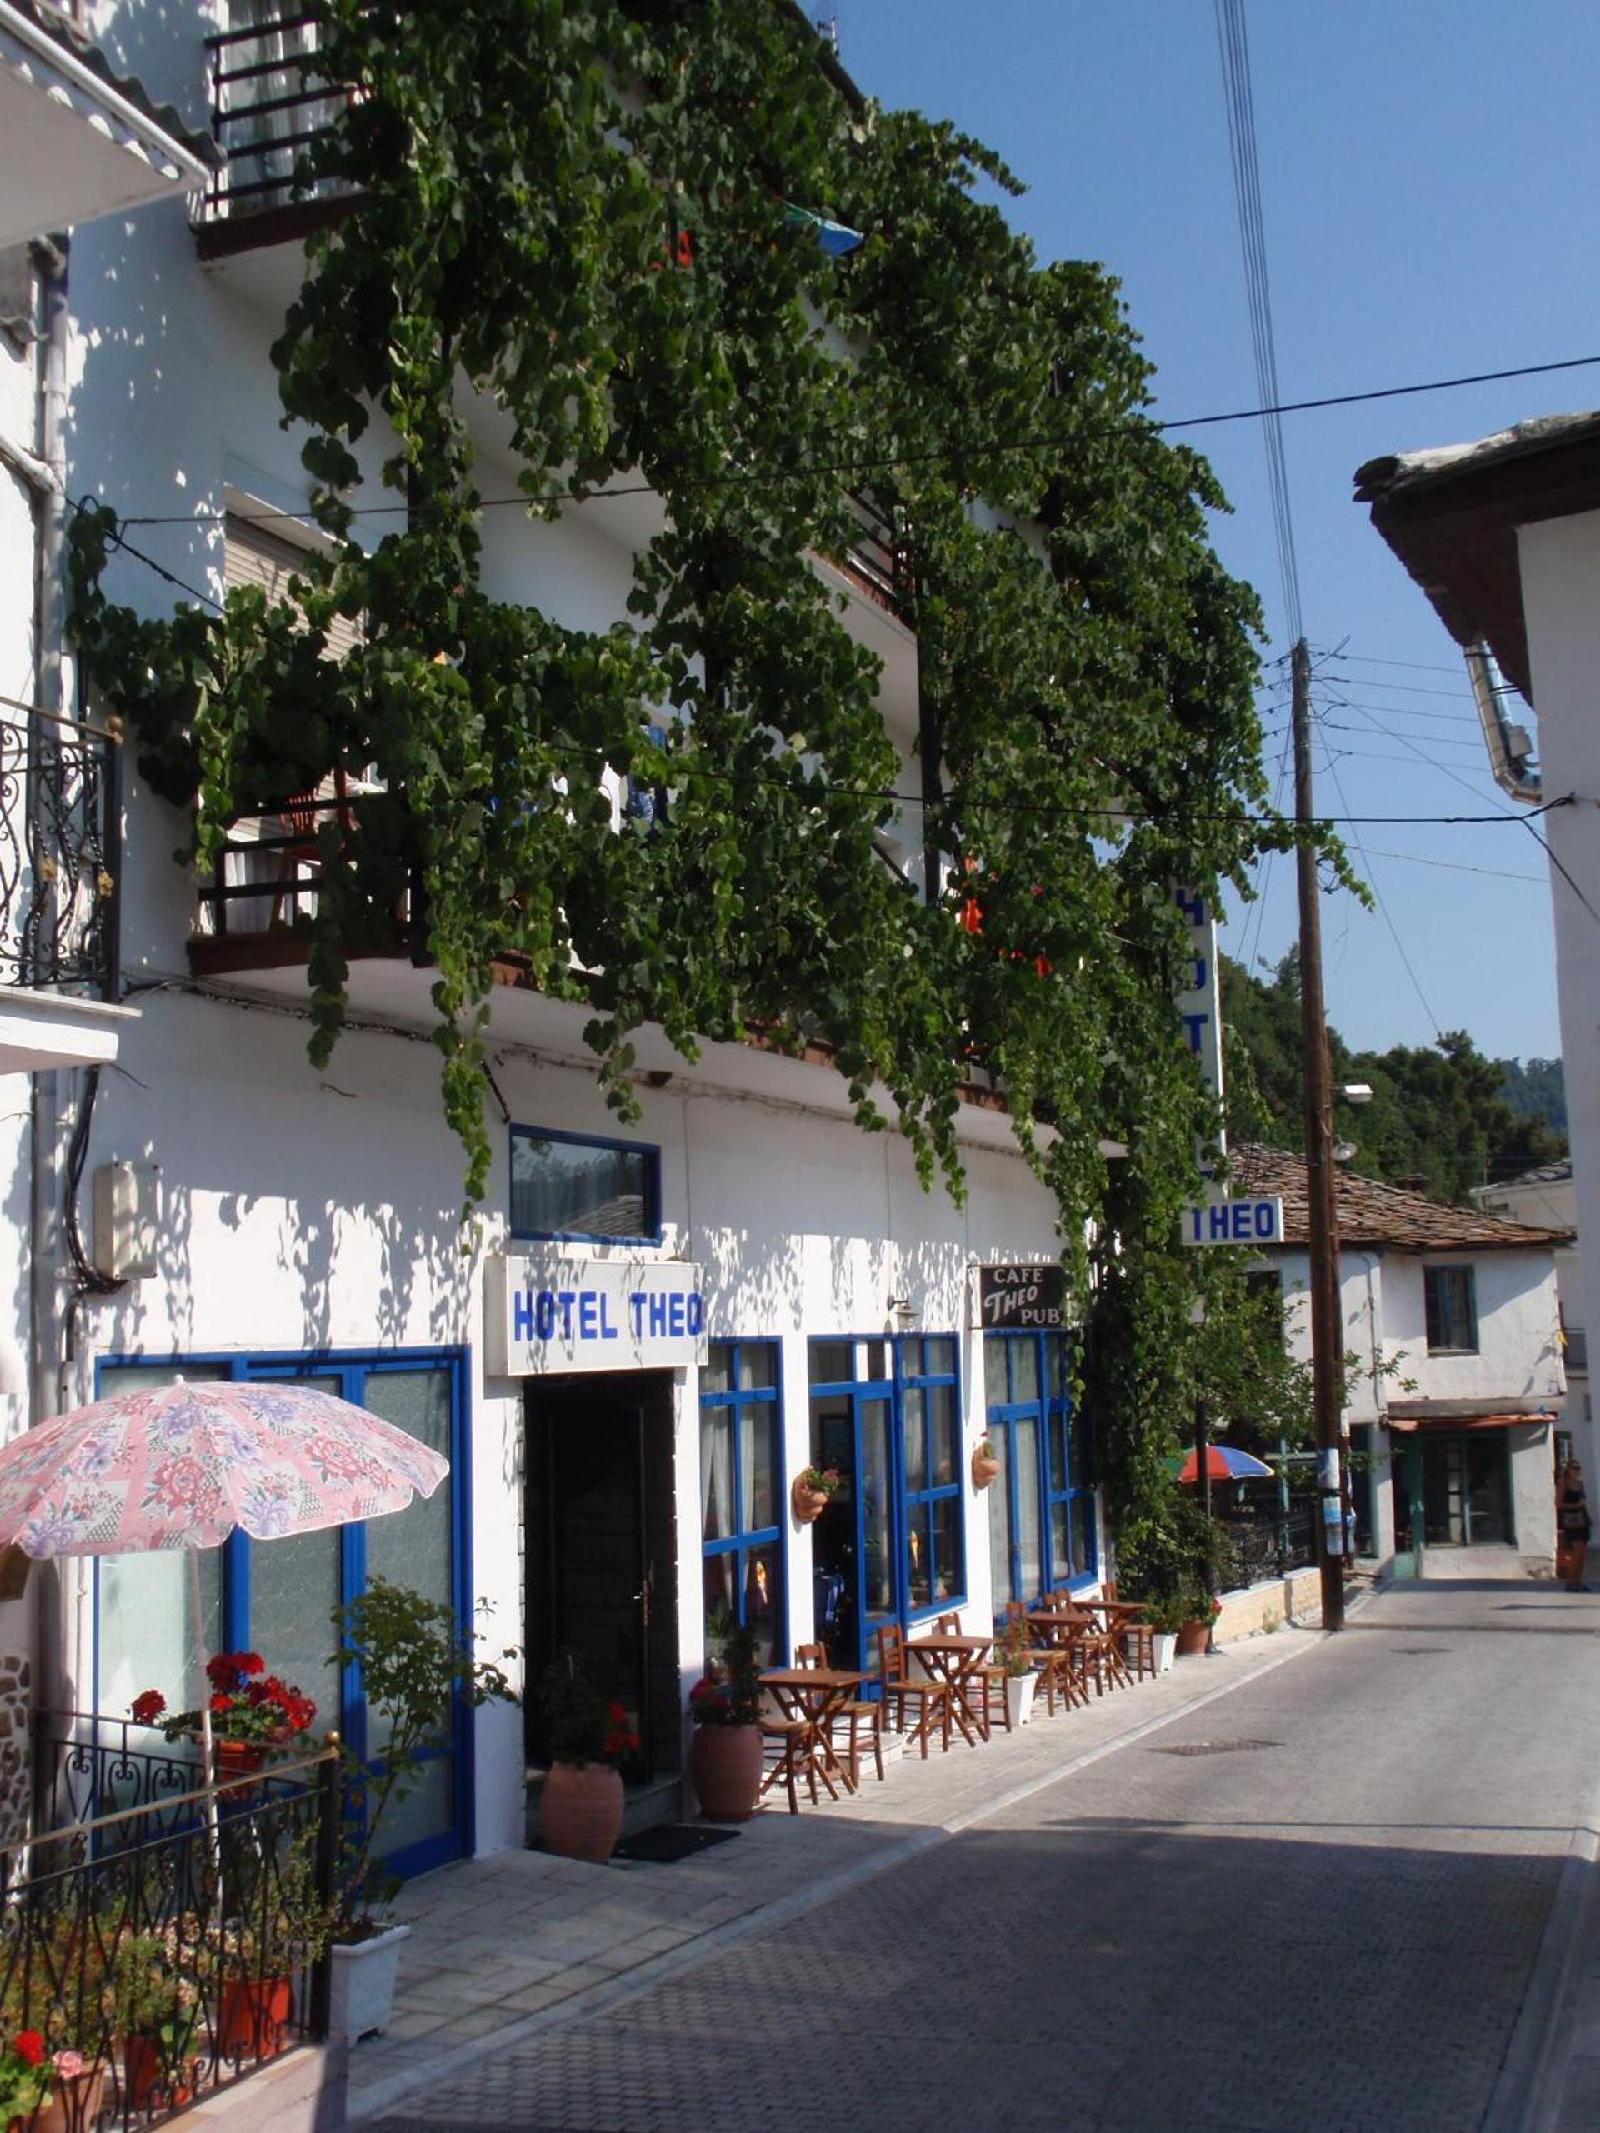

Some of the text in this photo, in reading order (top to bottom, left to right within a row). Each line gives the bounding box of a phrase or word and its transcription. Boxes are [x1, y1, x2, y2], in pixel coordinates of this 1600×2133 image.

[1192, 1202, 1274, 1240] THEO
[993, 1268, 1044, 1283] CAFE
[514, 1291, 702, 1341] HOTEL THEO
[1021, 1308, 1060, 1325] PUB
